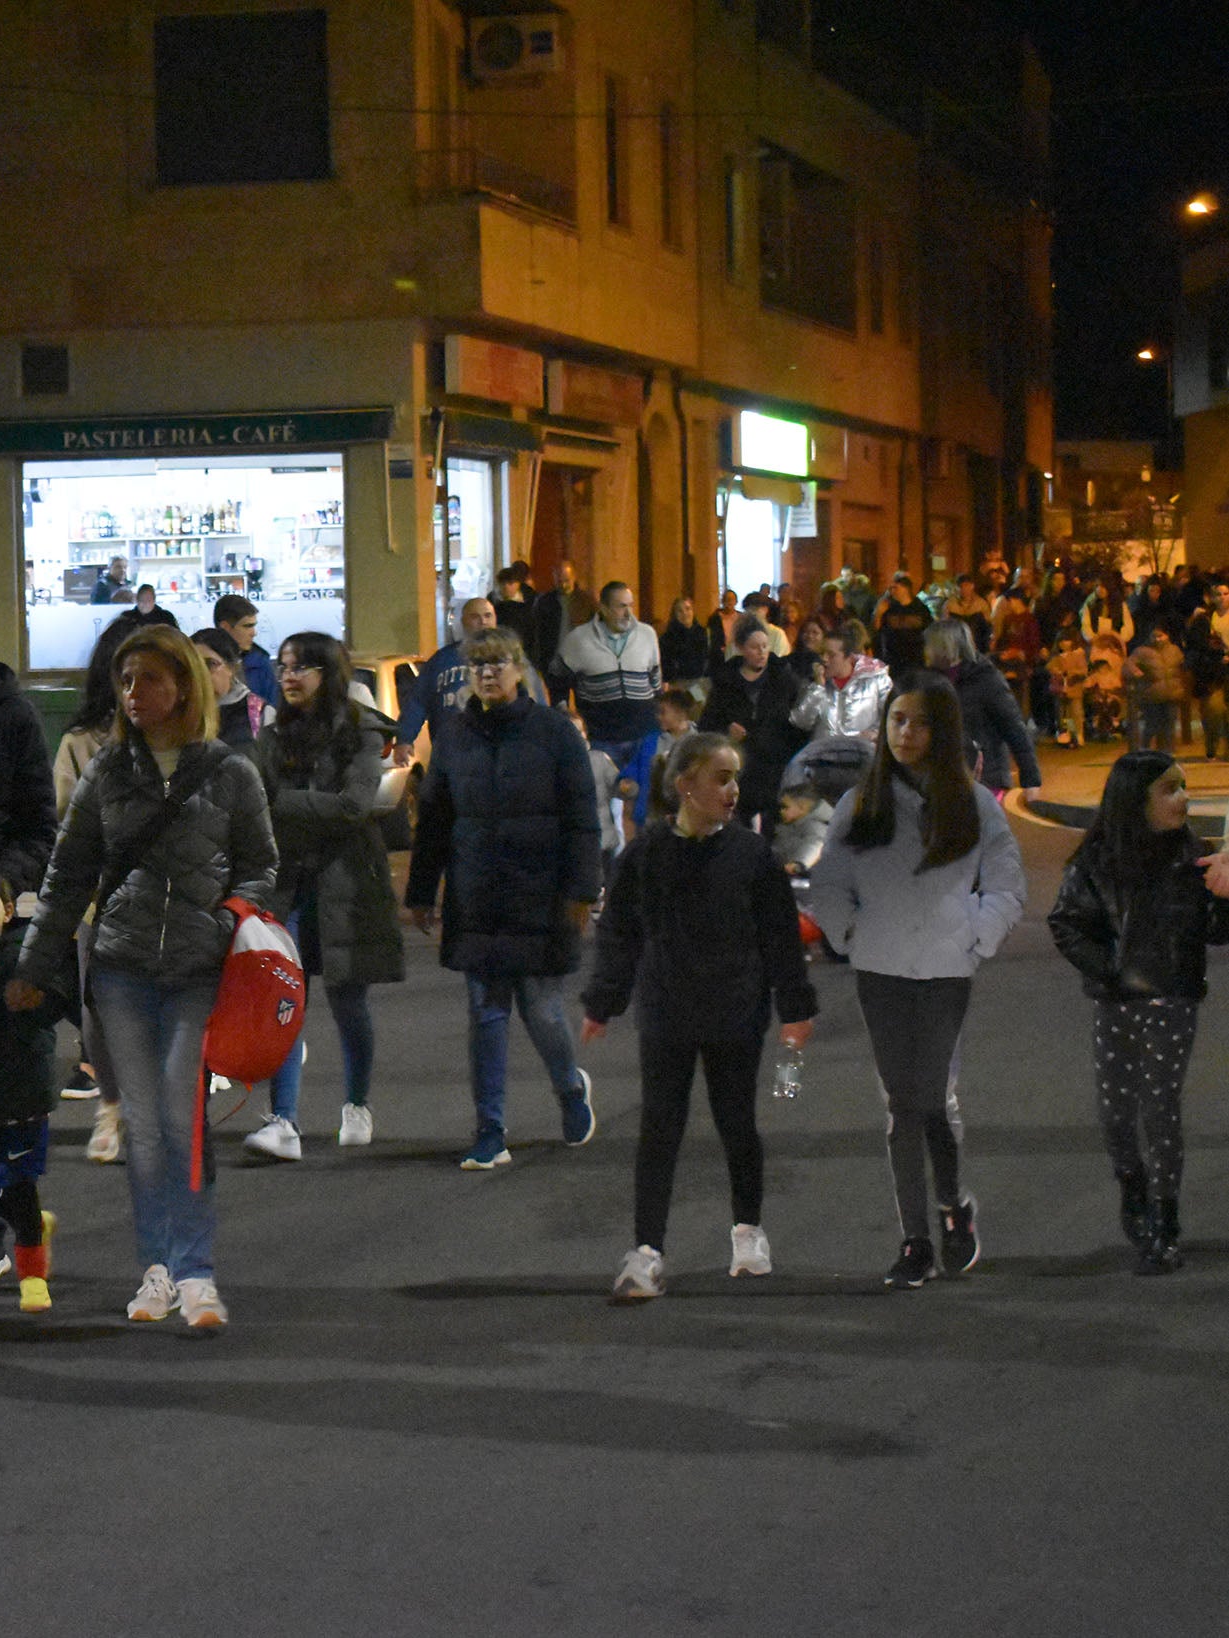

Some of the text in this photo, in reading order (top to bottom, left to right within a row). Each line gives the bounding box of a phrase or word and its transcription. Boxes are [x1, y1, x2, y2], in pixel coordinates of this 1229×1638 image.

[62, 427, 213, 449] PASTELERIA
[232, 419, 296, 443] CAFÉ
[436, 665, 470, 693] PITT
